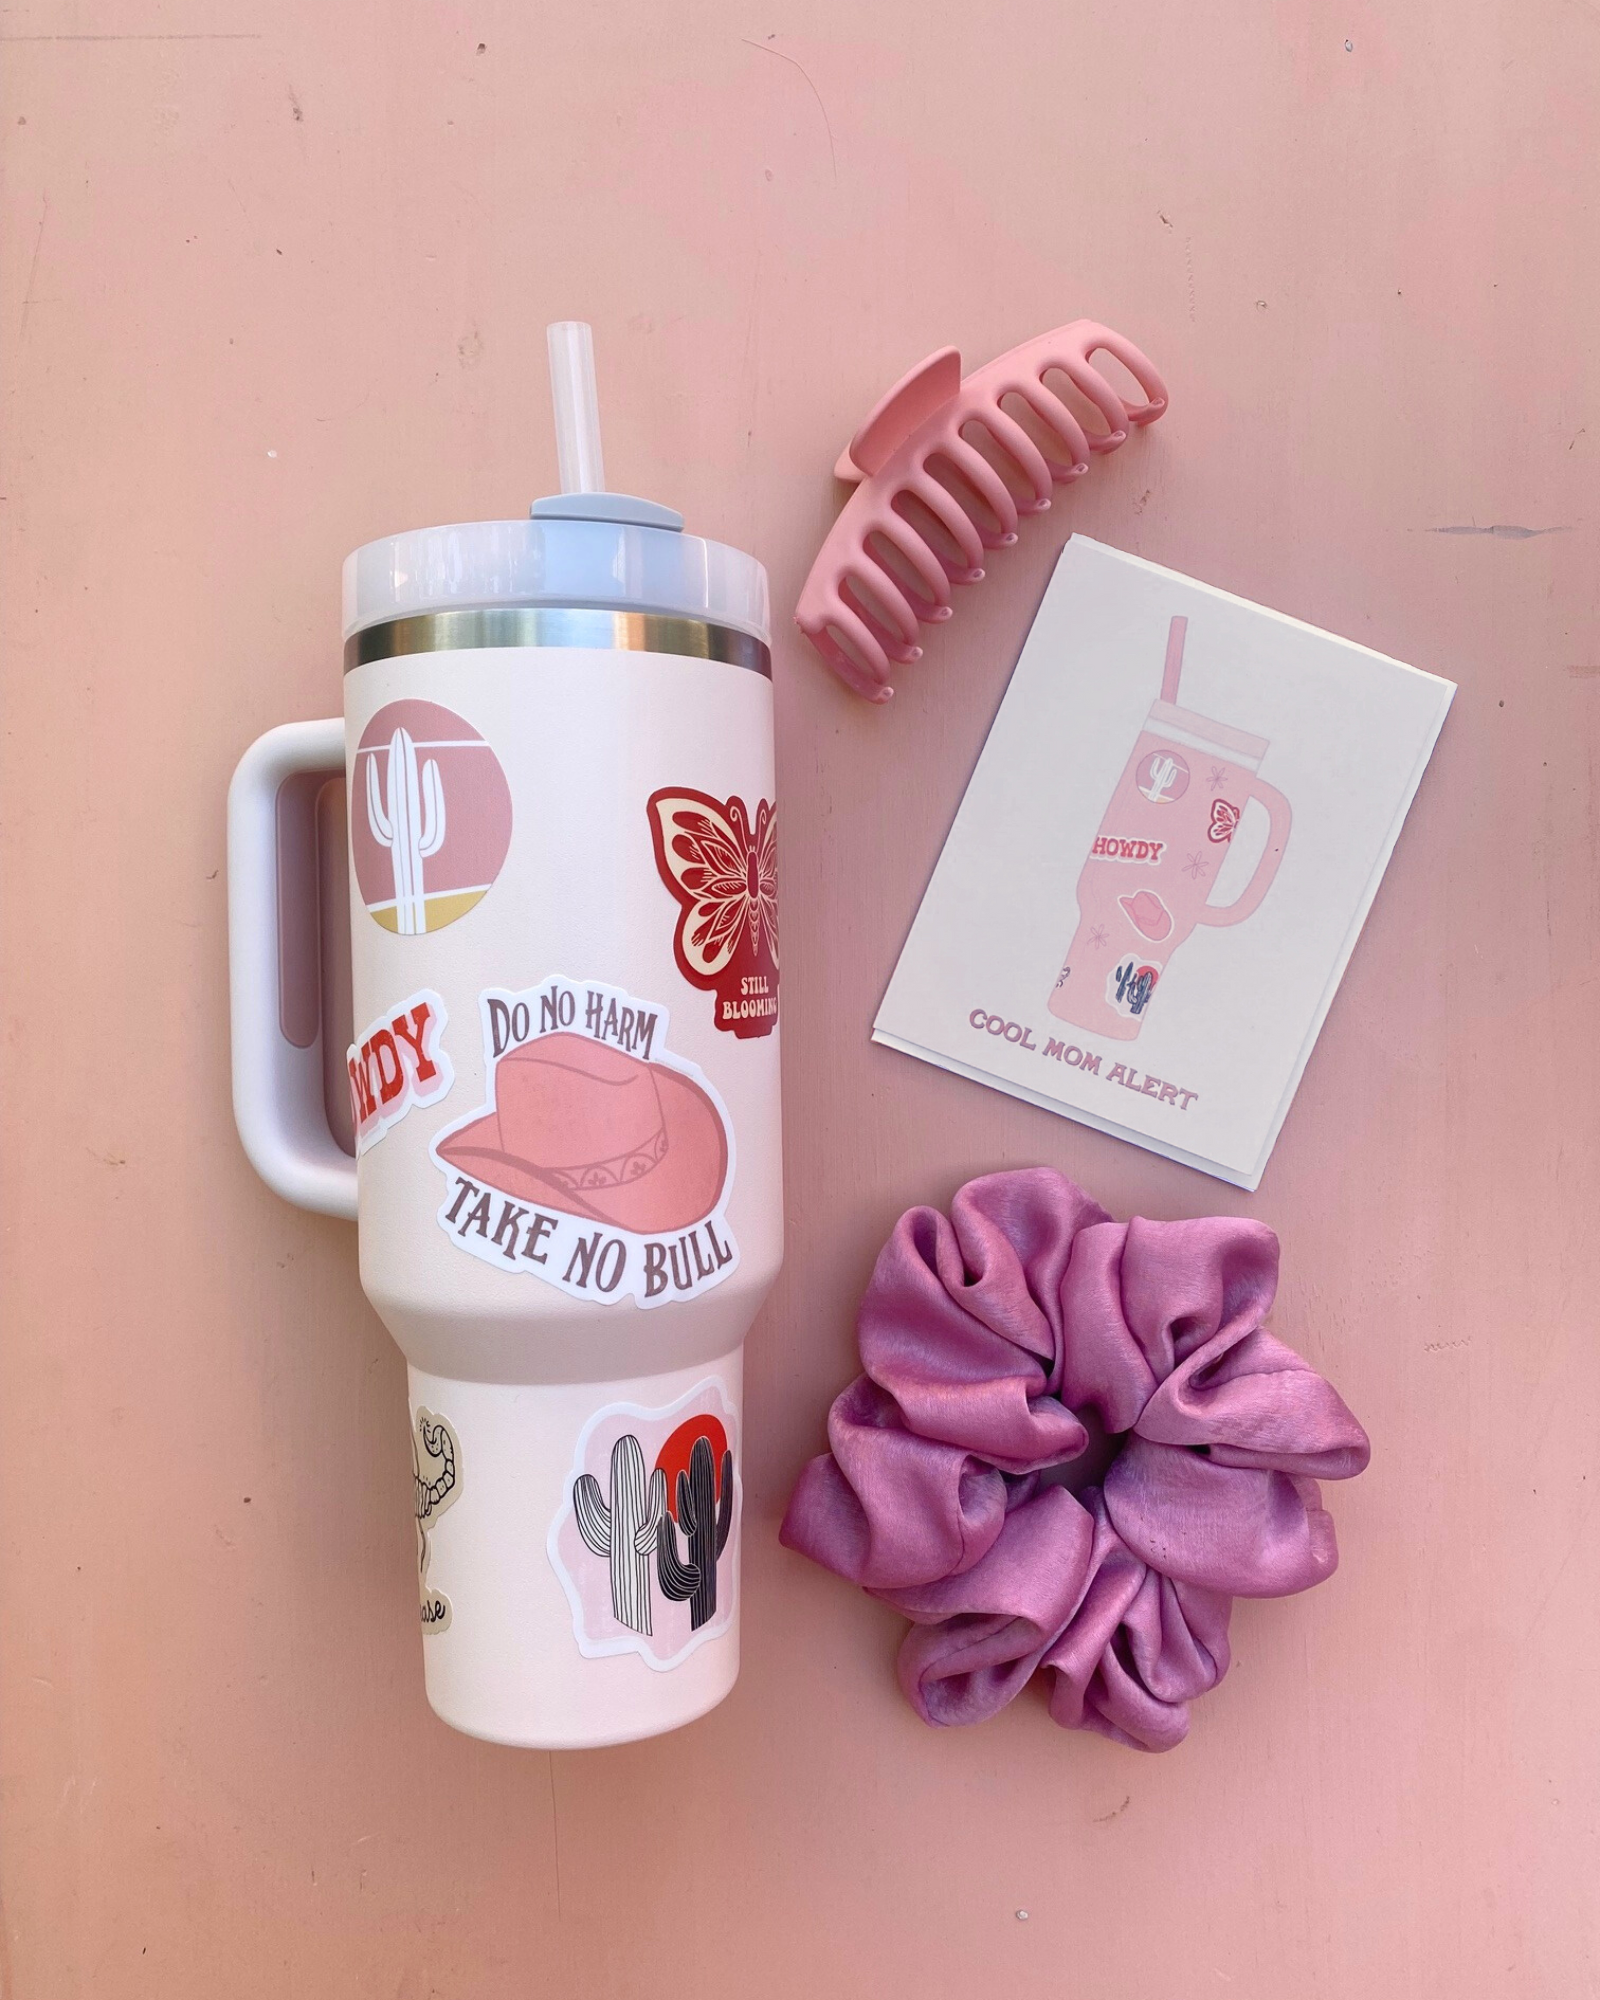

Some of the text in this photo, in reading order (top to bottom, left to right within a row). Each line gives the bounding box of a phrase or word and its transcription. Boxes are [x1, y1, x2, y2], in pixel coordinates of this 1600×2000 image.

[1092, 836, 1163, 861] HOWDY
[487, 985, 658, 1060] DO NO HARM
[740, 975, 769, 995] STILL
[348, 1001, 437, 1125] WDY
[969, 1008, 1199, 1111] COOL MOM ALERT
[444, 1176, 733, 1298] TAKE NO BULL
[420, 1599, 446, 1623] ase
